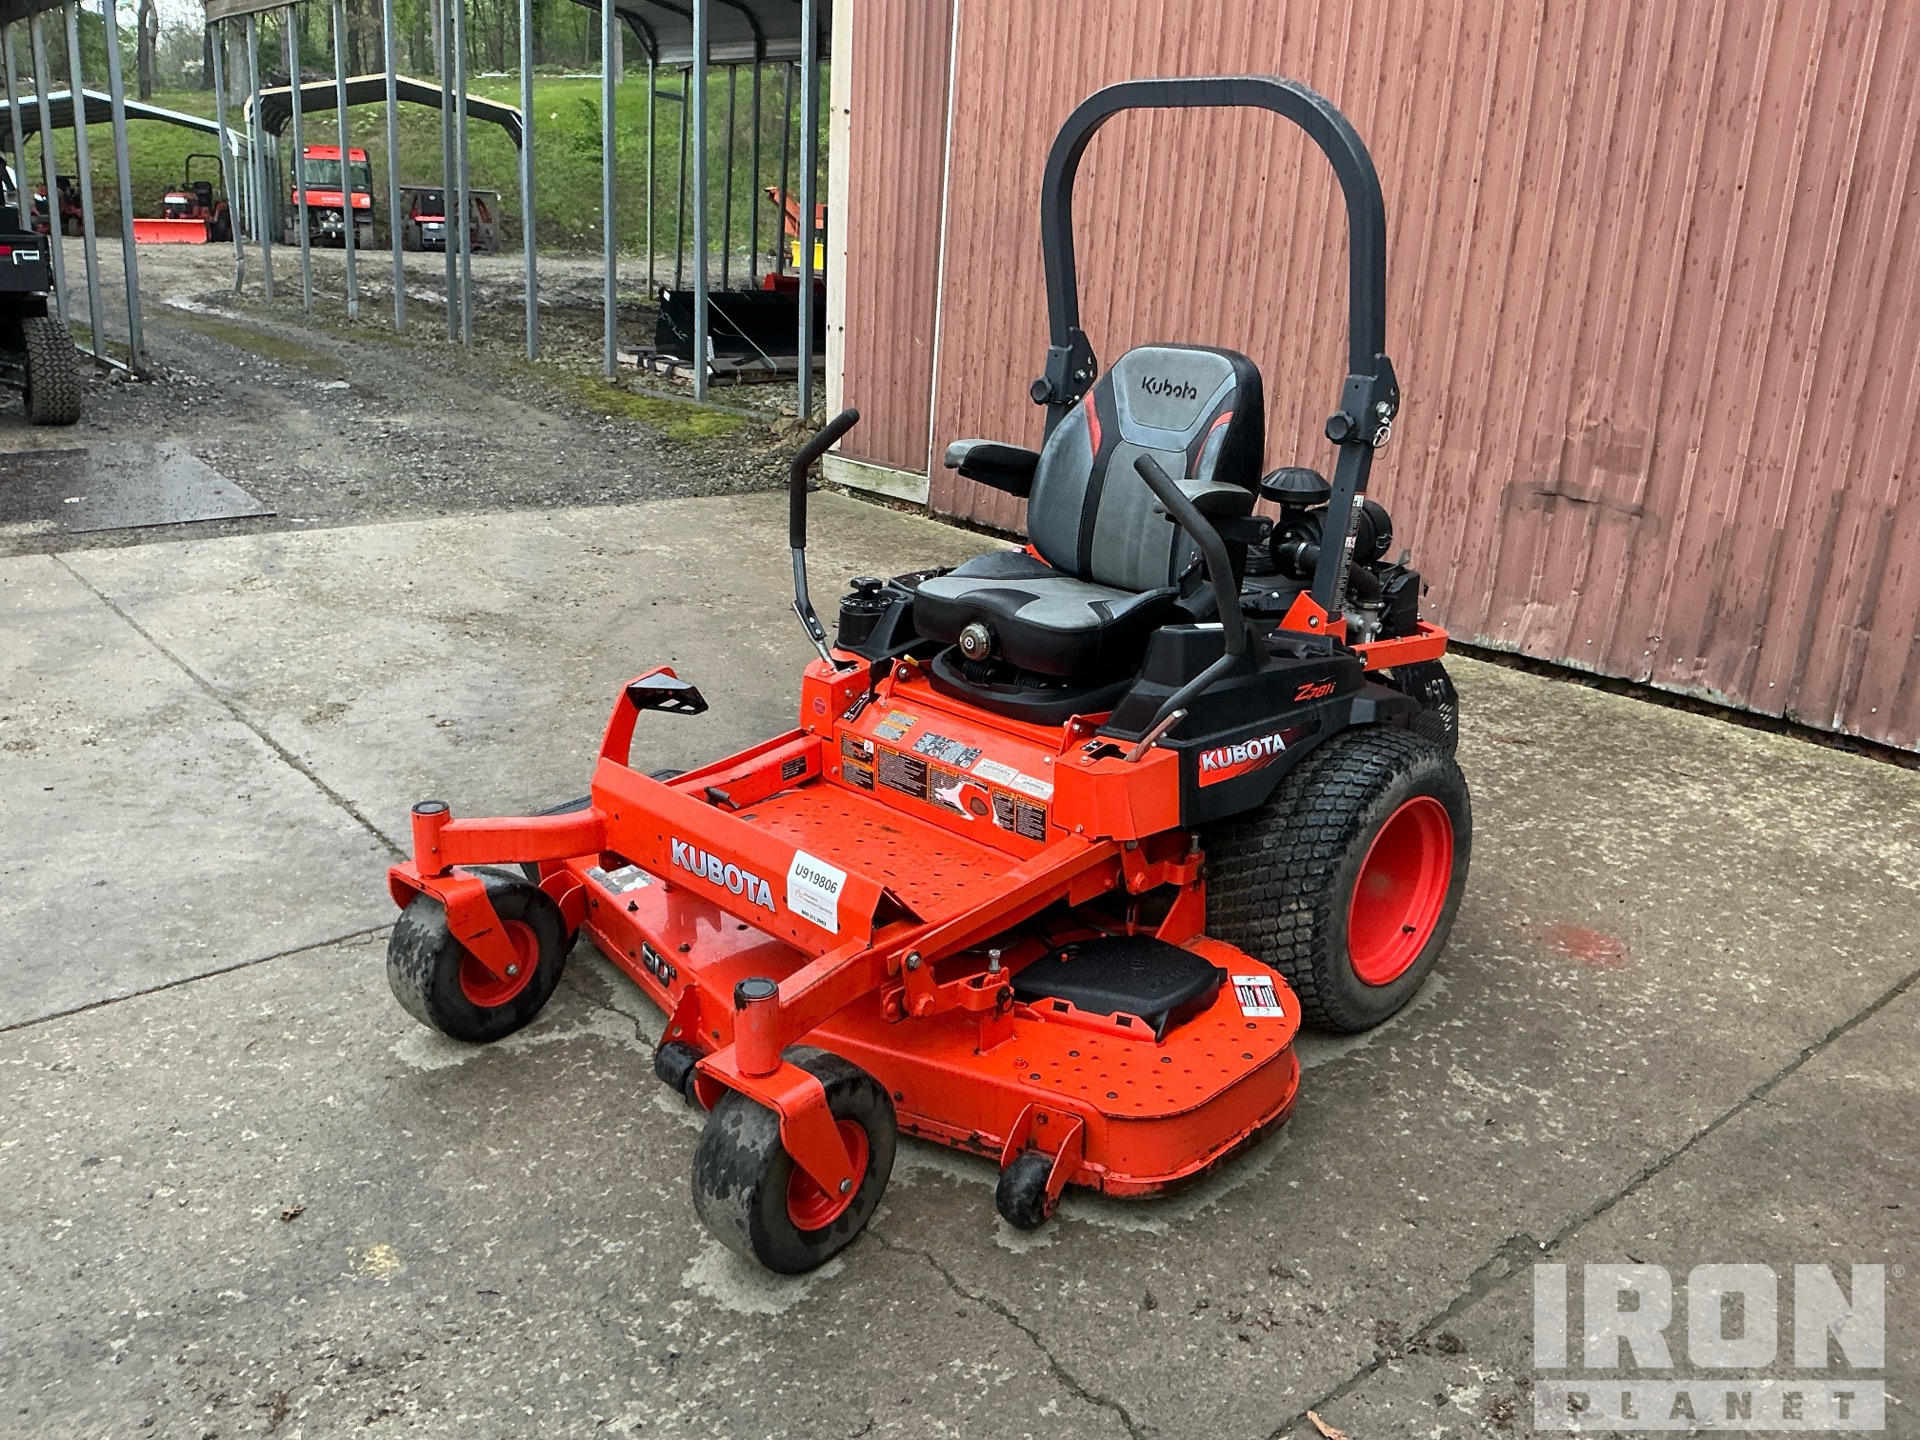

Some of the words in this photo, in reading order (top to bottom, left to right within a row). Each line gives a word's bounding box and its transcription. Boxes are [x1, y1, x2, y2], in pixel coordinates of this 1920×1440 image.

[1141, 376, 1198, 400] Kubota
[1293, 681, 1337, 702] Z781i
[1202, 733, 1287, 773] KUBOTA
[671, 836, 777, 914] KUBOTA
[795, 863, 838, 894] U919806
